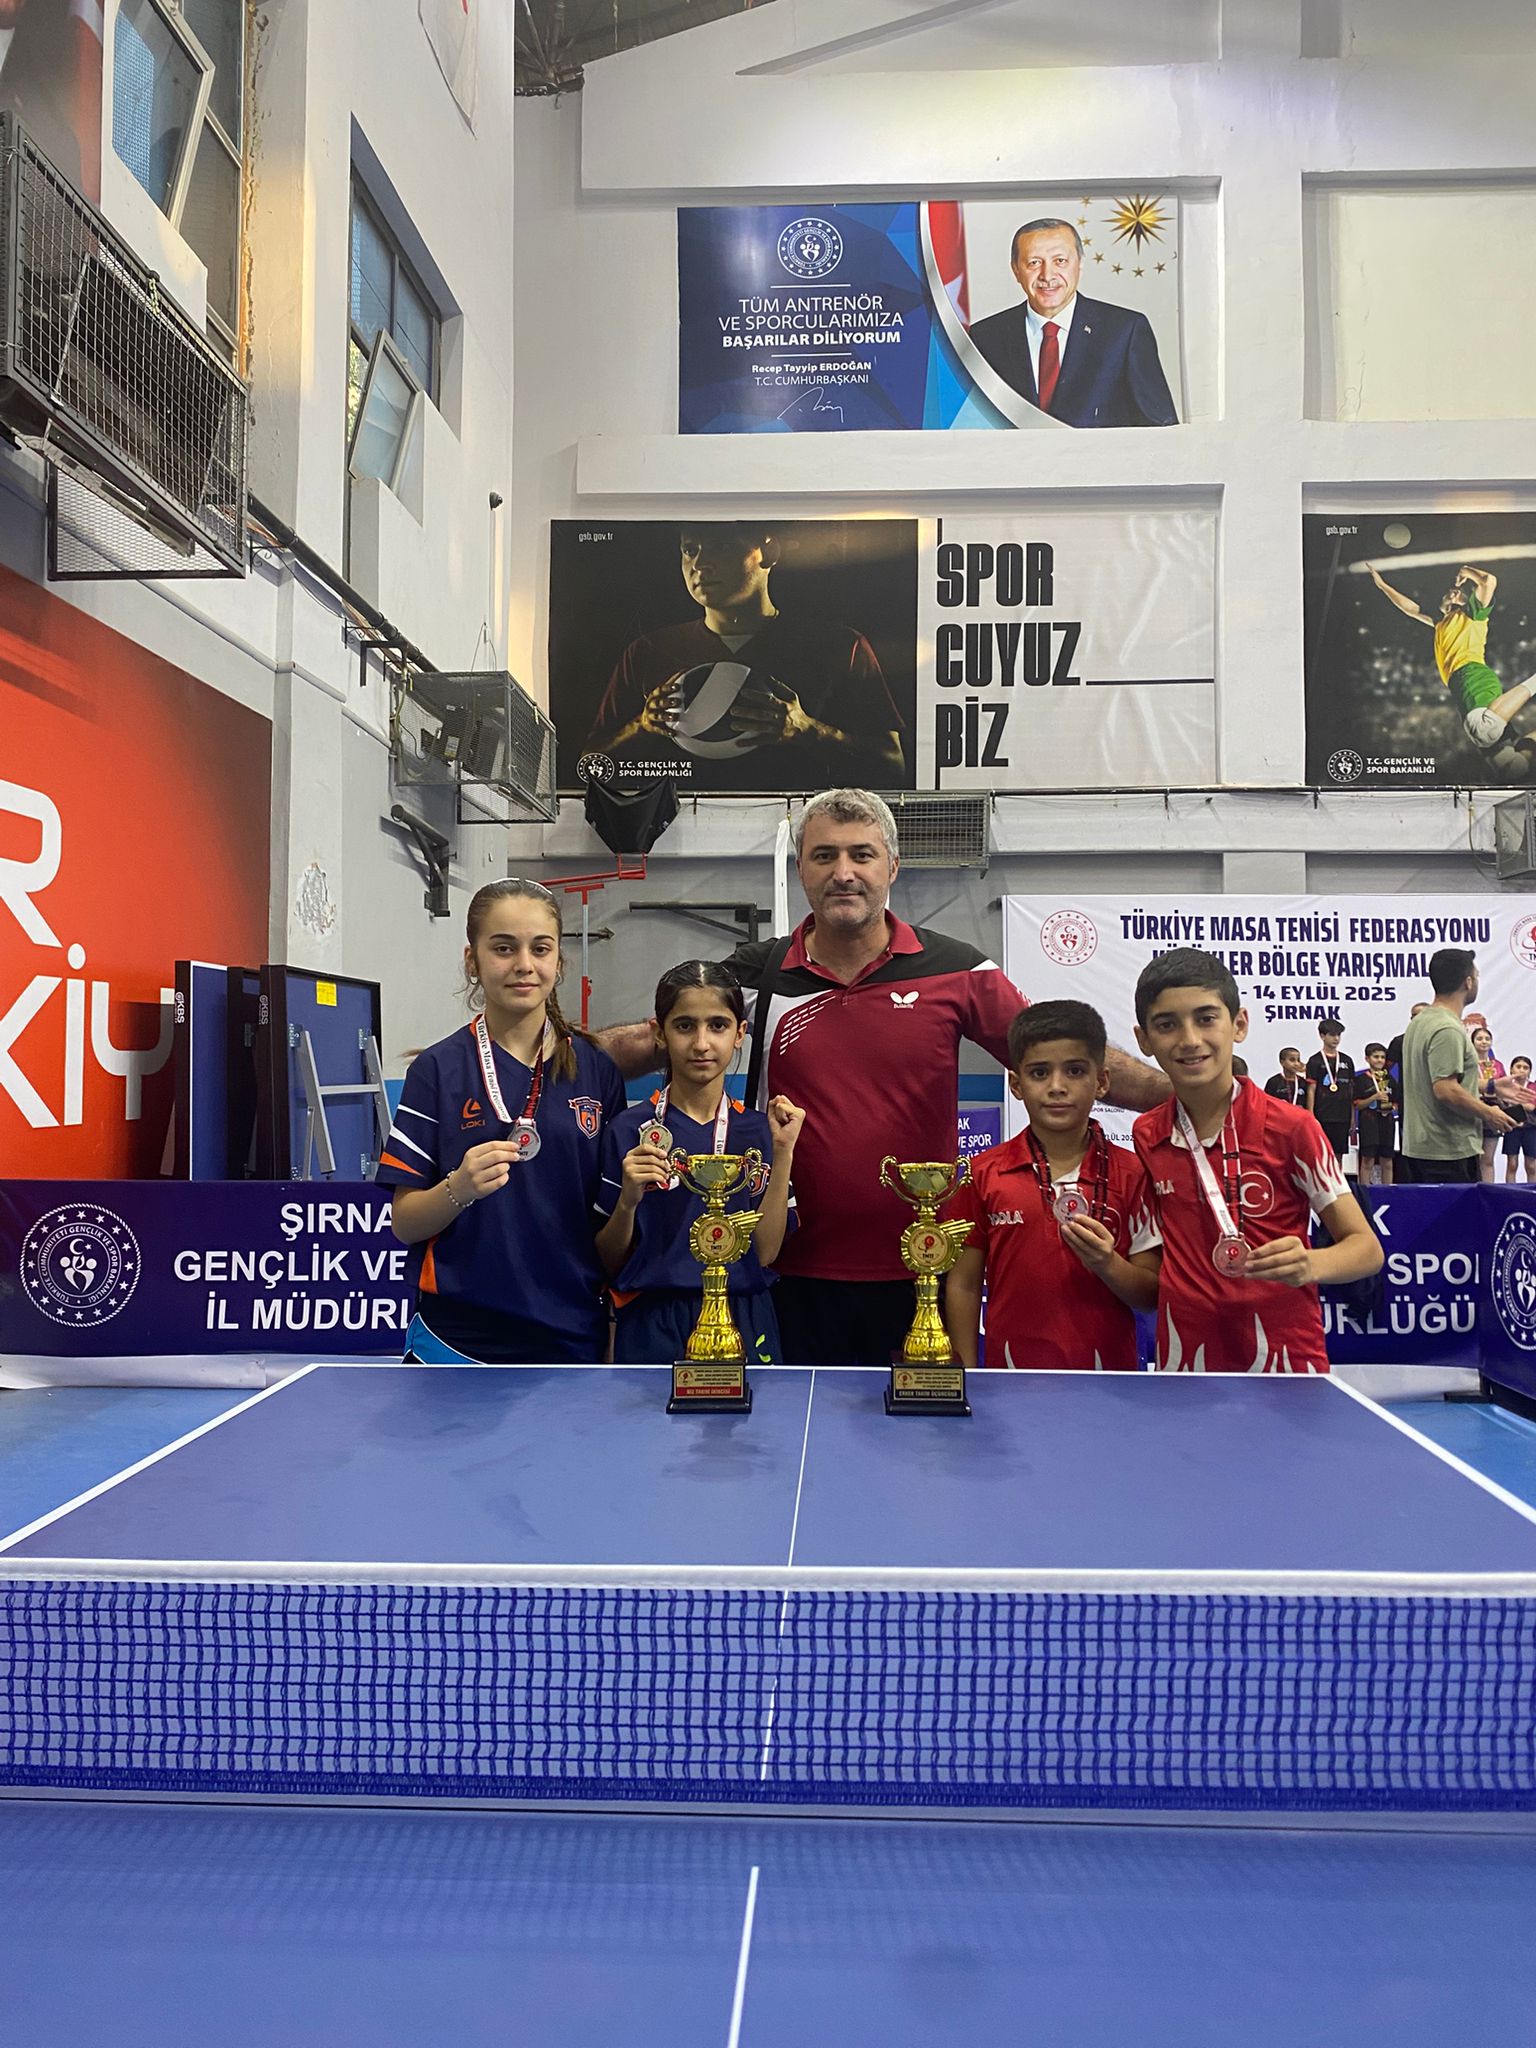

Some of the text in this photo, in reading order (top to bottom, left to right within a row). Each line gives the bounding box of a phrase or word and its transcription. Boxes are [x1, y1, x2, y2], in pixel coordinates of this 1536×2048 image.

[739, 293, 883, 314] TÜM ANTRENÖR
[718, 312, 904, 331] VE SPORCULARIMIZA
[722, 330, 901, 350] BAŞARILAR DİLİYORUM
[752, 360, 872, 375] Recep Tayyip ERDOĞAN
[754, 374, 869, 387] T.C. CUMHURBAŞKANI
[578, 531, 614, 543] gsb.gov.tr
[937, 542, 1054, 607] SPOR
[936, 622, 1081, 687] CUYUZ
[935, 696, 1009, 768] BİZ
[637, 760, 679, 770] GENÇLİK
[1366, 756, 1435, 766] T.C. GENÇLİK VE
[1366, 765, 1436, 774] SPOR BAKANLIĞI
[619, 768, 692, 777] SPOR BAKANLIĞI
[1120, 909, 1204, 940] TÜRKİYE
[1210, 916, 1271, 941] MASA
[1275, 911, 1339, 942] TENİSİ
[1350, 917, 1490, 943] FEDERASYONU
[1259, 945, 1320, 976] BÖLGE
[1253, 985, 1276, 1000] 14
[1281, 982, 1340, 1001] EYLÜL
[1345, 986, 1397, 1001] 2025
[1265, 1004, 1341, 1022] ŞIRNAK
[968, 1133, 992, 1148] SPOR
[174, 1243, 409, 1289] GENÇLİK VE
[206, 1291, 239, 1330] İL
